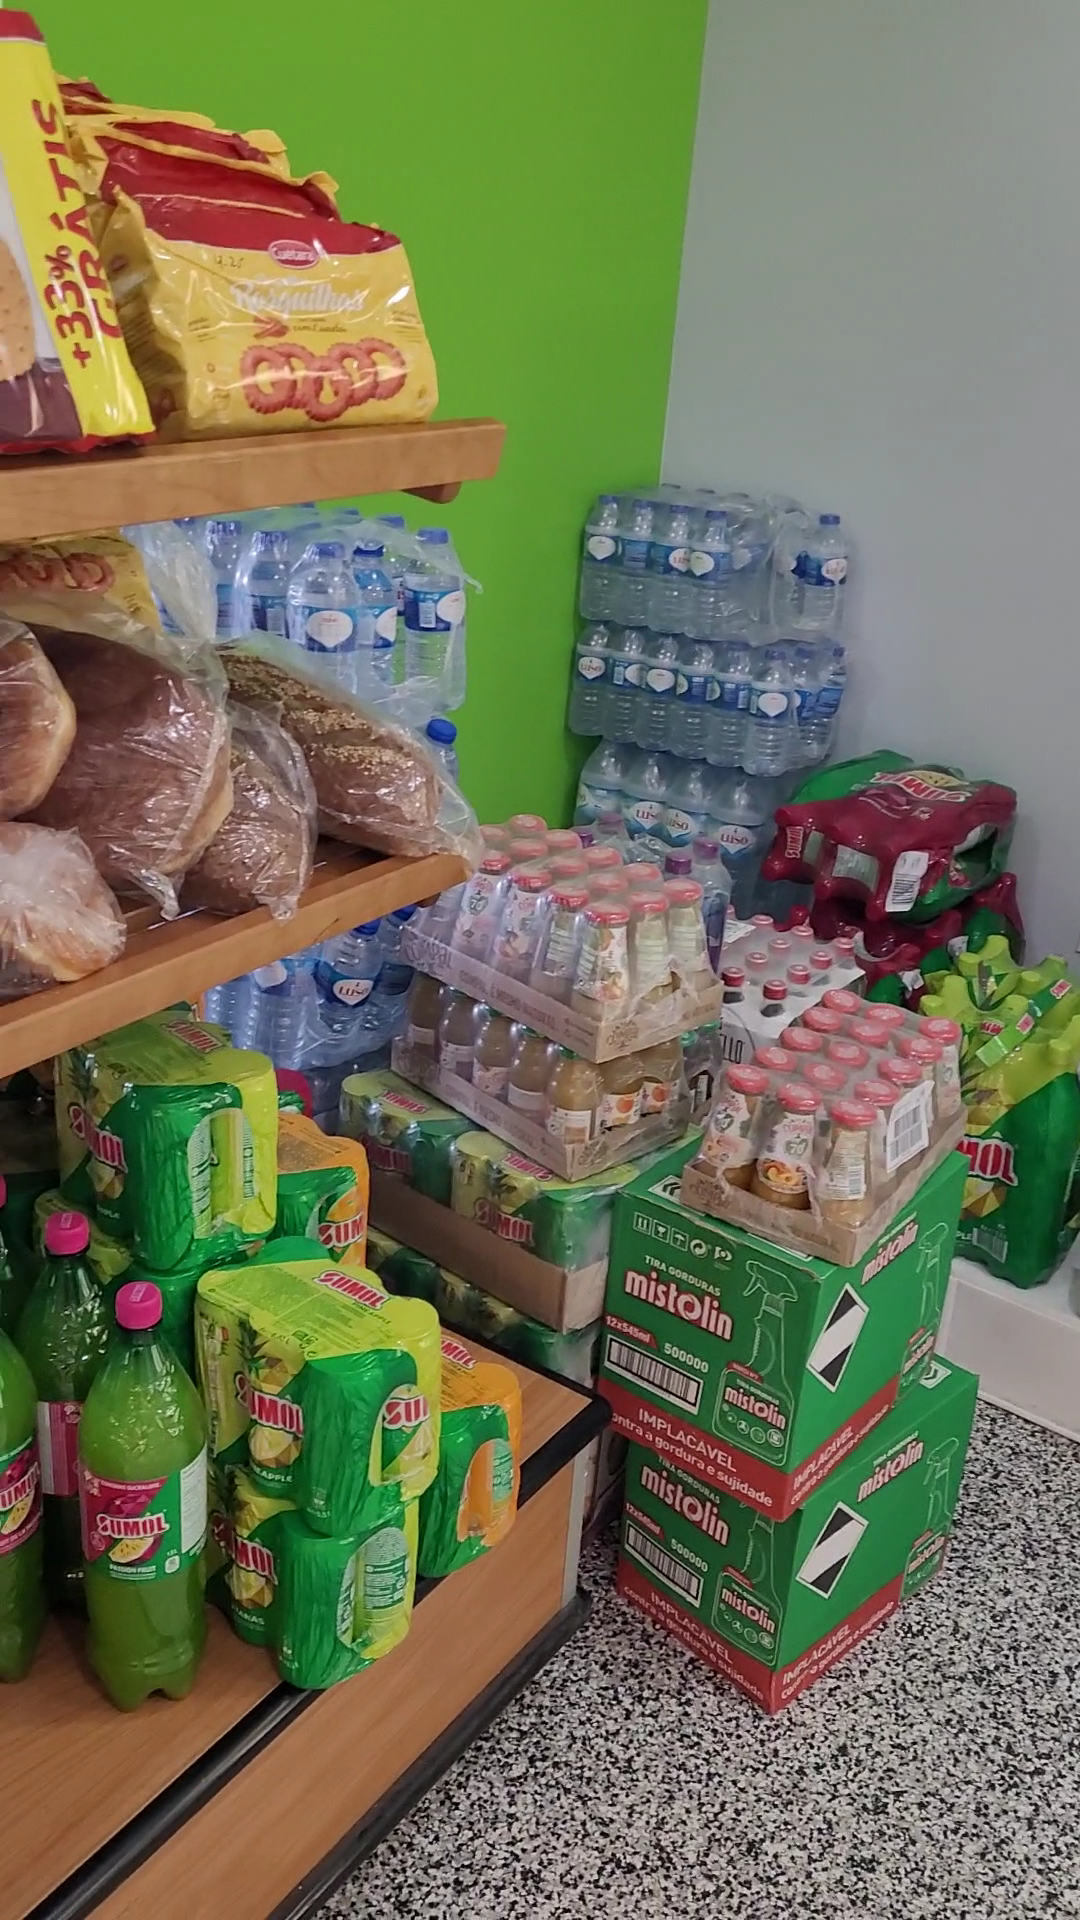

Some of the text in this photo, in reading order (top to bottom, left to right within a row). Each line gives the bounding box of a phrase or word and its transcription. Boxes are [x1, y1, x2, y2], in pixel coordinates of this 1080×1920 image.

[31, 99, 122, 339] GRÁTIS
[44, 245, 94, 369] +33%
[162, 1020, 222, 1054] SUMOL
[313, 1270, 389, 1311] SUMOL
[645, 1254, 721, 1297] TIRA GORDURAS
[625, 1270, 734, 1341] mistolin
[441, 1339, 477, 1369] MOL
[664, 1342, 709, 1374] 500000
[724, 1385, 786, 1430] mistolin
[612, 1412, 773, 1507] ontra a gordura e sujidade
[857, 1440, 924, 1503] mistolin
[641, 1465, 730, 1547] mistolin
[676, 1469, 720, 1504] GORDURAS
[97, 1513, 171, 1539] SUMOL
[721, 1588, 776, 1634] mistolin
